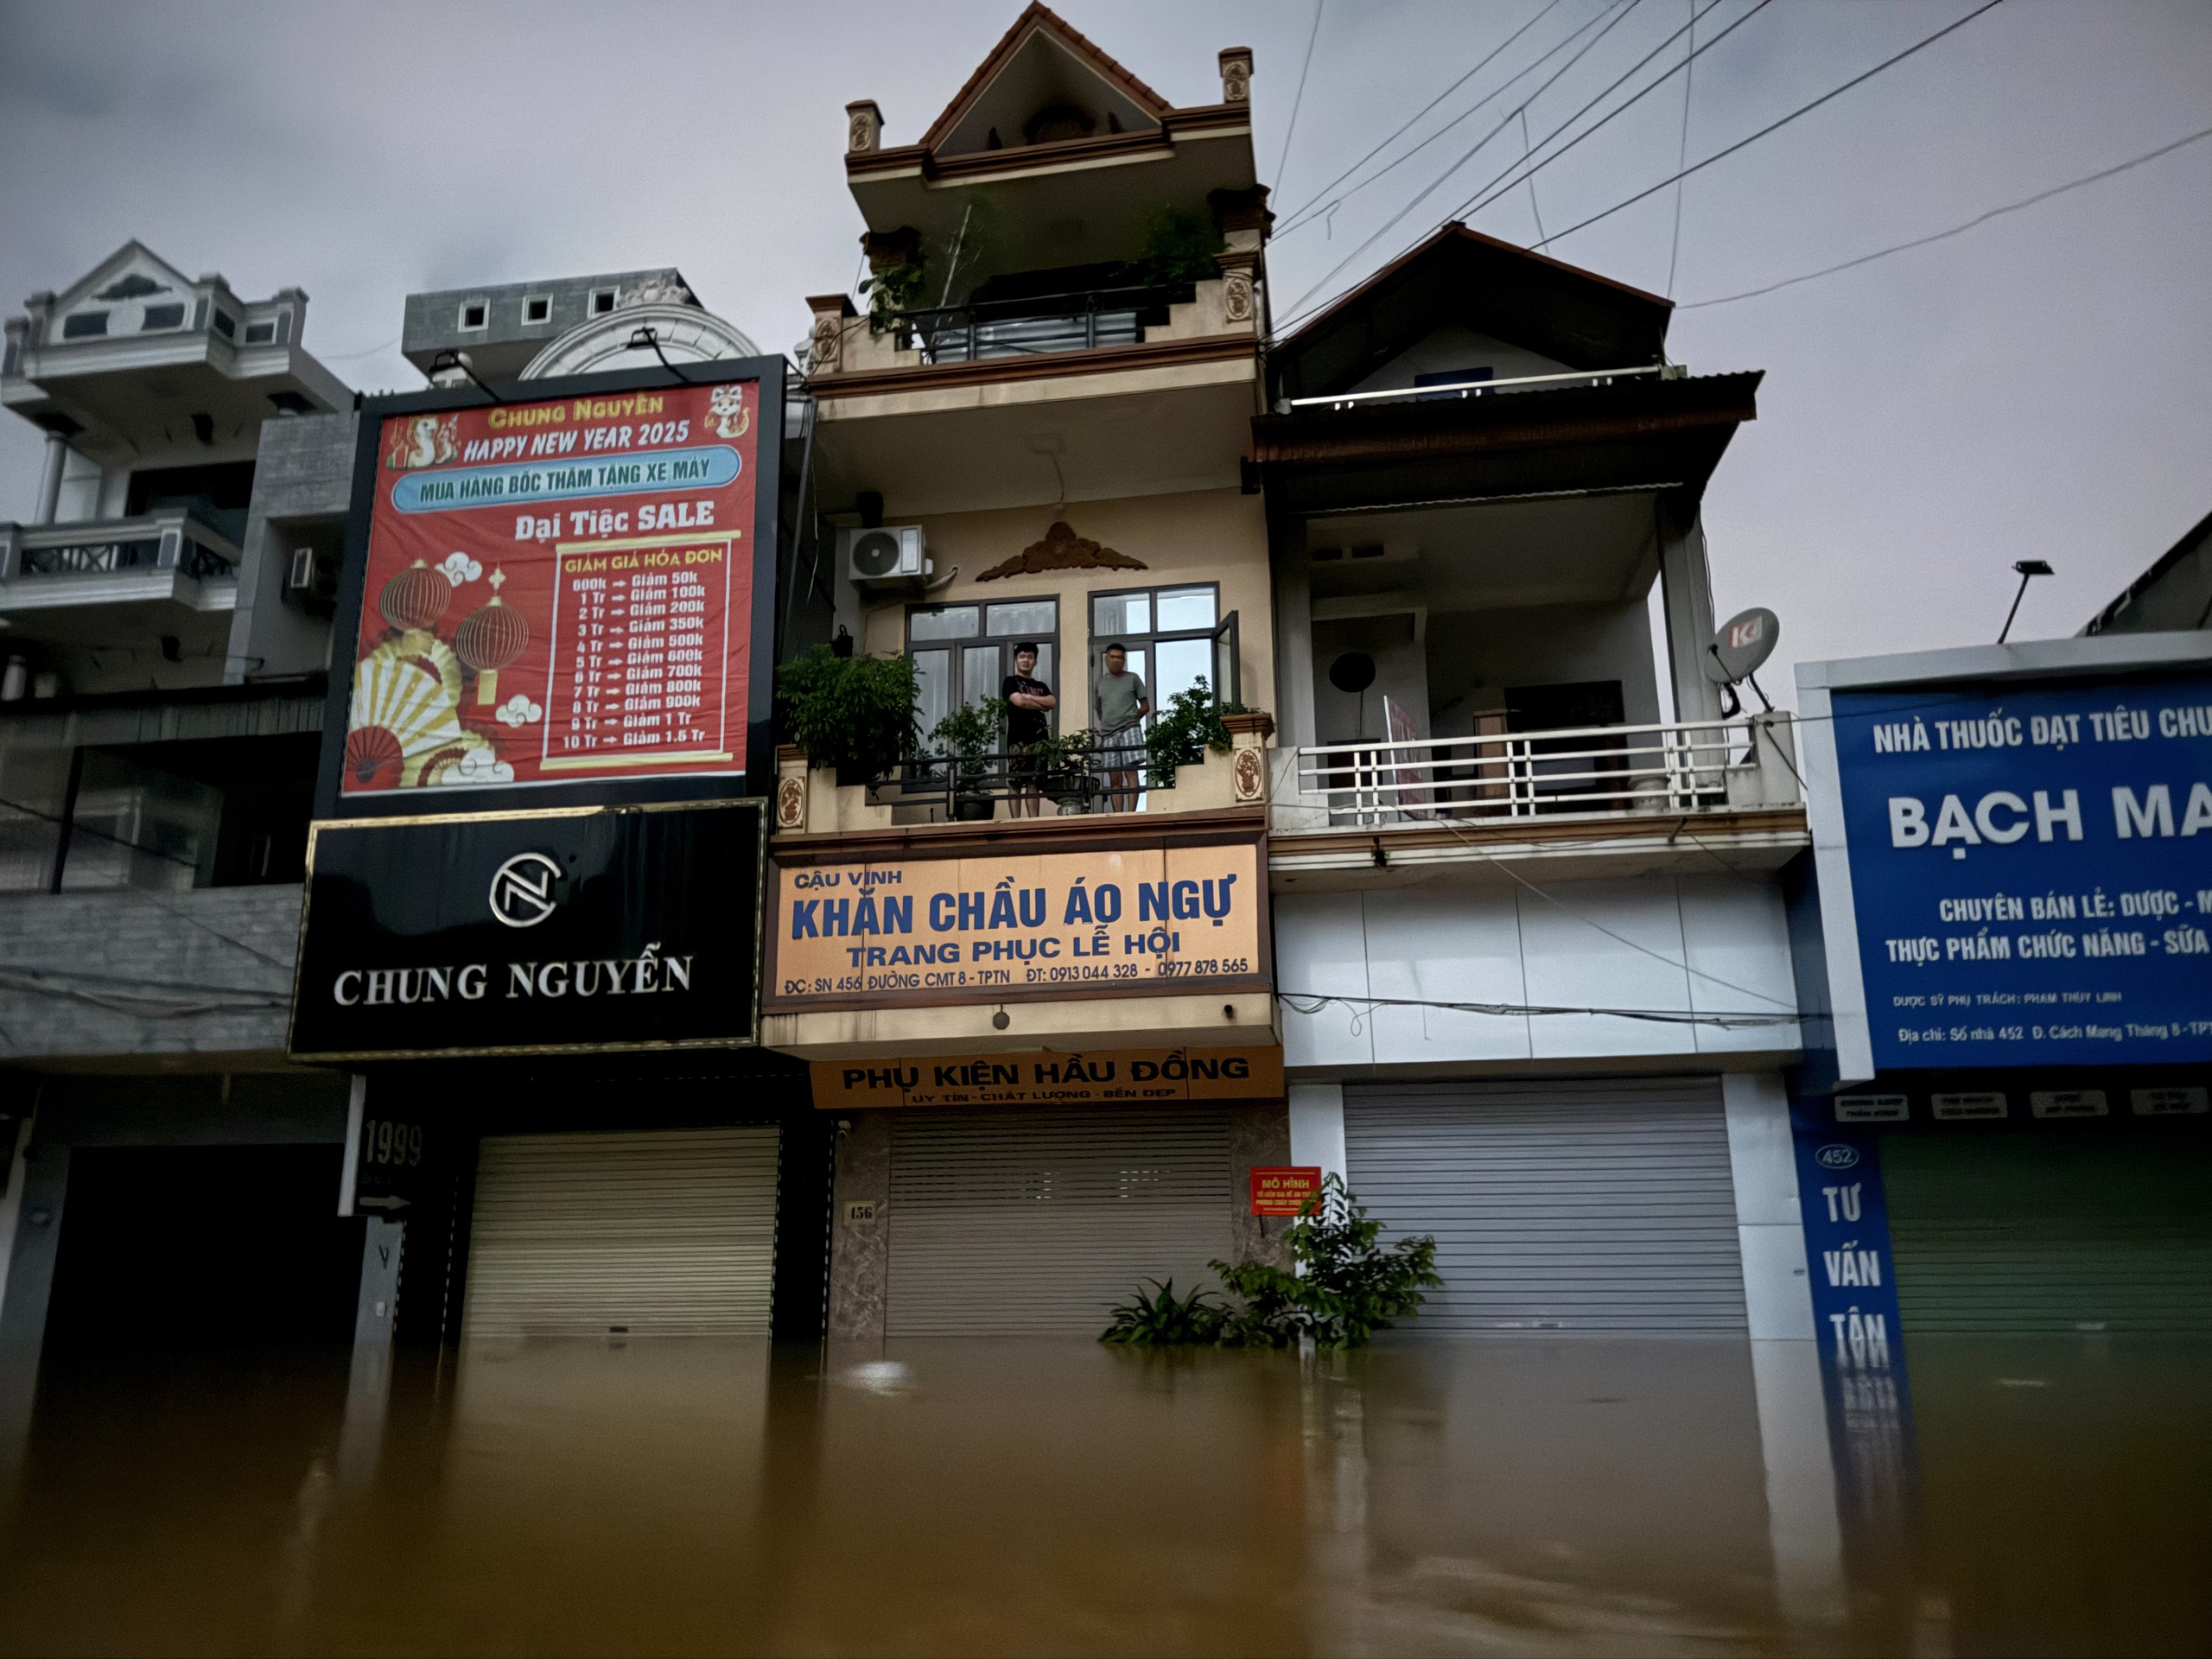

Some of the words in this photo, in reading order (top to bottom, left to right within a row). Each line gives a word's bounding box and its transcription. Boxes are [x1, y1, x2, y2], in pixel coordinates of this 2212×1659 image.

[463, 435, 529, 463] HAPPY
[530, 430, 578, 456] NEW
[583, 426, 632, 451] YEAR
[638, 420, 690, 446] 2025
[420, 482, 454, 502] MUA
[460, 475, 504, 499] HÀNG
[508, 467, 542, 493] BỐC
[646, 463, 667, 482] XE
[673, 456, 709, 480] MÁY
[515, 512, 561, 543] Đại
[569, 508, 629, 538] Tiệc
[638, 500, 715, 531] SALE
[565, 552, 607, 573] GIẢM
[644, 548, 680, 567] HÓA
[684, 548, 722, 565] ĐƠN
[671, 570, 698, 585] 50k
[581, 593, 587, 605] 1
[592, 592, 607, 604] Tr
[671, 585, 705, 599] 100k
[579, 607, 588, 620] 2
[591, 607, 606, 619] Tr
[670, 600, 705, 613] 200k
[578, 624, 587, 637] 3
[590, 623, 605, 635] Tr
[669, 616, 704, 631] 350k
[576, 640, 585, 653] 4
[589, 639, 604, 652] Tr
[668, 633, 703, 647] 500k
[576, 656, 585, 669] 5
[589, 655, 602, 668] Tr
[588, 671, 601, 683] Tr
[667, 664, 702, 677] 700k
[574, 686, 582, 699] 7
[587, 685, 601, 698] Tr
[666, 679, 702, 693] 800k
[586, 701, 600, 713] Tr
[665, 695, 701, 709] 900k
[571, 717, 581, 730] 9
[584, 716, 598, 729] Tr
[665, 712, 672, 725] 1
[677, 711, 692, 724] Tr
[1873, 715, 1931, 753] NHÀ
[1935, 707, 2024, 750] THUỐC
[2031, 714, 2081, 752] ĐẠT
[2088, 704, 2150, 742] TIÊU
[563, 736, 580, 748] 10
[584, 734, 598, 747] Tr
[691, 728, 705, 741] Tr
[1888, 788, 2084, 860] BẠCH
[794, 870, 841, 891] CẬU
[791, 887, 913, 940] KHĂN
[929, 875, 1046, 932] CHẦU
[1063, 876, 1122, 926] ÁO
[1138, 873, 1237, 926] NGỰ
[1939, 892, 2024, 922] CHUYÊN
[2031, 890, 2076, 920] BÁN
[2120, 889, 2179, 921] DƯỢC
[846, 942, 961, 968] TRANG
[972, 937, 1061, 965] PHỤC
[1072, 924, 1110, 957] LỄ
[1124, 926, 1180, 959] HỘI
[1885, 936, 1941, 967] THỰC
[1946, 926, 2011, 960] PHẨM
[2018, 929, 2076, 958] CHỨC
[2082, 926, 2145, 957] NĂNG
[2164, 923, 2210, 954] SỮA
[334, 963, 488, 1006] CHUNG
[505, 940, 694, 999] NGUYỄN
[785, 979, 812, 994] ĐC:
[815, 977, 832, 993] SN
[836, 976, 861, 992] 456
[868, 969, 921, 989] ĐƯỜNG
[925, 972, 956, 987] CMT
[957, 971, 967, 985] 8
[977, 969, 1011, 984] TPTN
[1026, 968, 1046, 982] ĐT:
[1050, 966, 1080, 982] 0913
[1083, 964, 1109, 980] 044
[1113, 963, 1138, 978] 328
[1158, 961, 1192, 976] 0977
[1194, 959, 1218, 975] 878
[1222, 957, 1249, 973] 565
[1949, 1025, 1967, 1041] Số
[1999, 1026, 2024, 1040] 452
[842, 1066, 919, 1092] PHỤ
[934, 1060, 1020, 1090] KIỆN
[1034, 1053, 1116, 1084] HẦU
[1130, 1050, 1249, 1081] ĐỒNG
[365, 1118, 423, 1167] 1999
[1821, 1148, 1853, 1165] 452
[1262, 1177, 1280, 1189] MÔ
[1283, 1177, 1310, 1189] HÌNH
[1821, 1182, 1862, 1223] TƯ
[1822, 1239, 1881, 1287] VẤN
